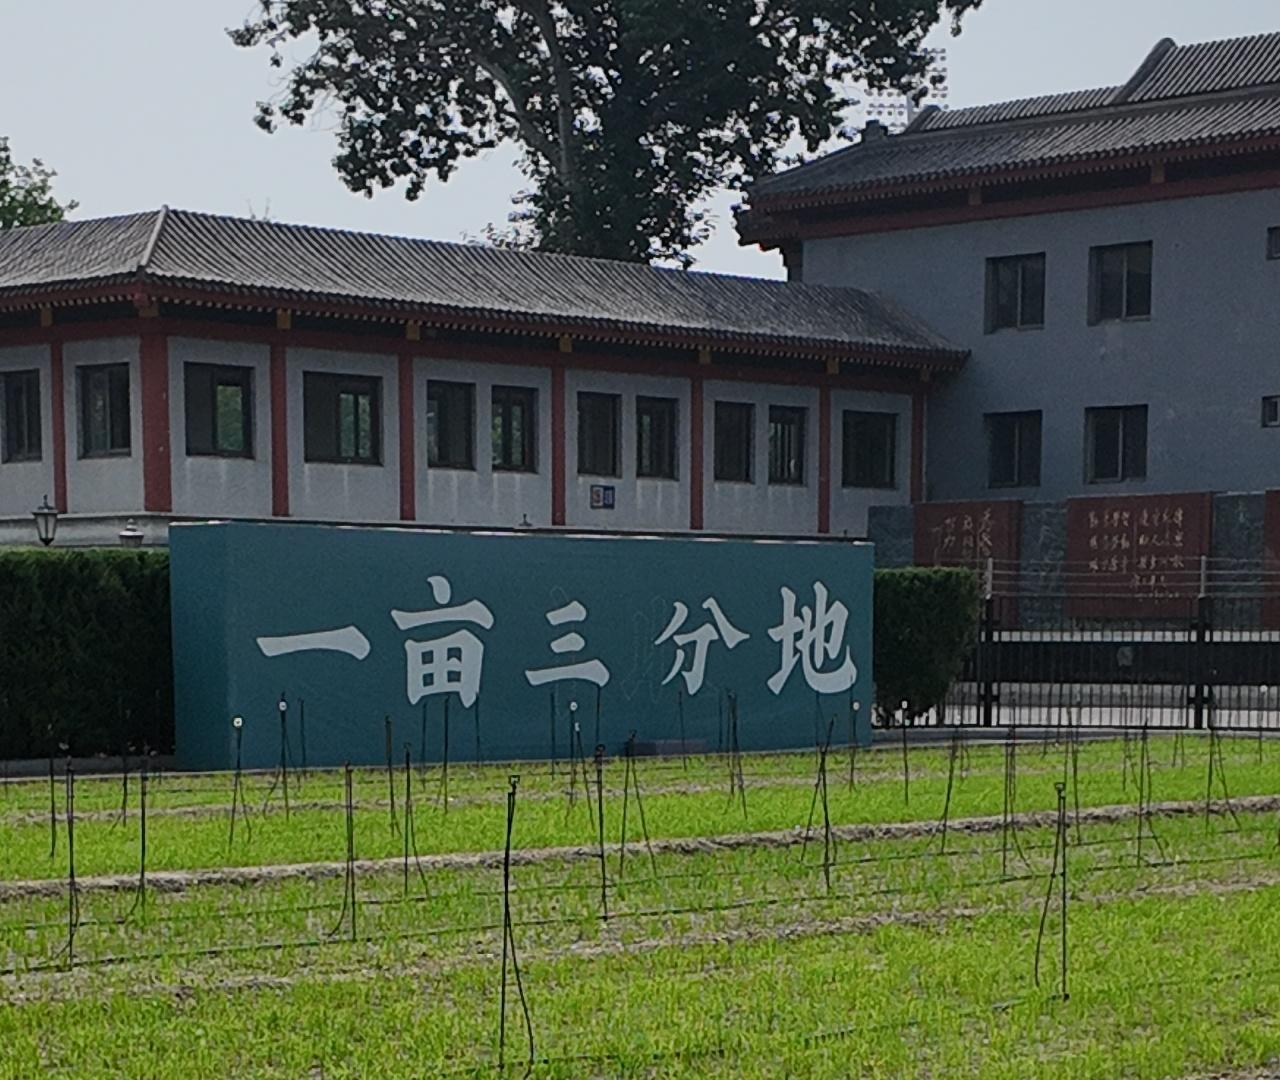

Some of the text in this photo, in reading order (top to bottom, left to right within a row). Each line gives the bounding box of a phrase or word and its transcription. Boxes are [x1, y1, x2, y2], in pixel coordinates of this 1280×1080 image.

[256, 575, 859, 708] 一亩三分地
